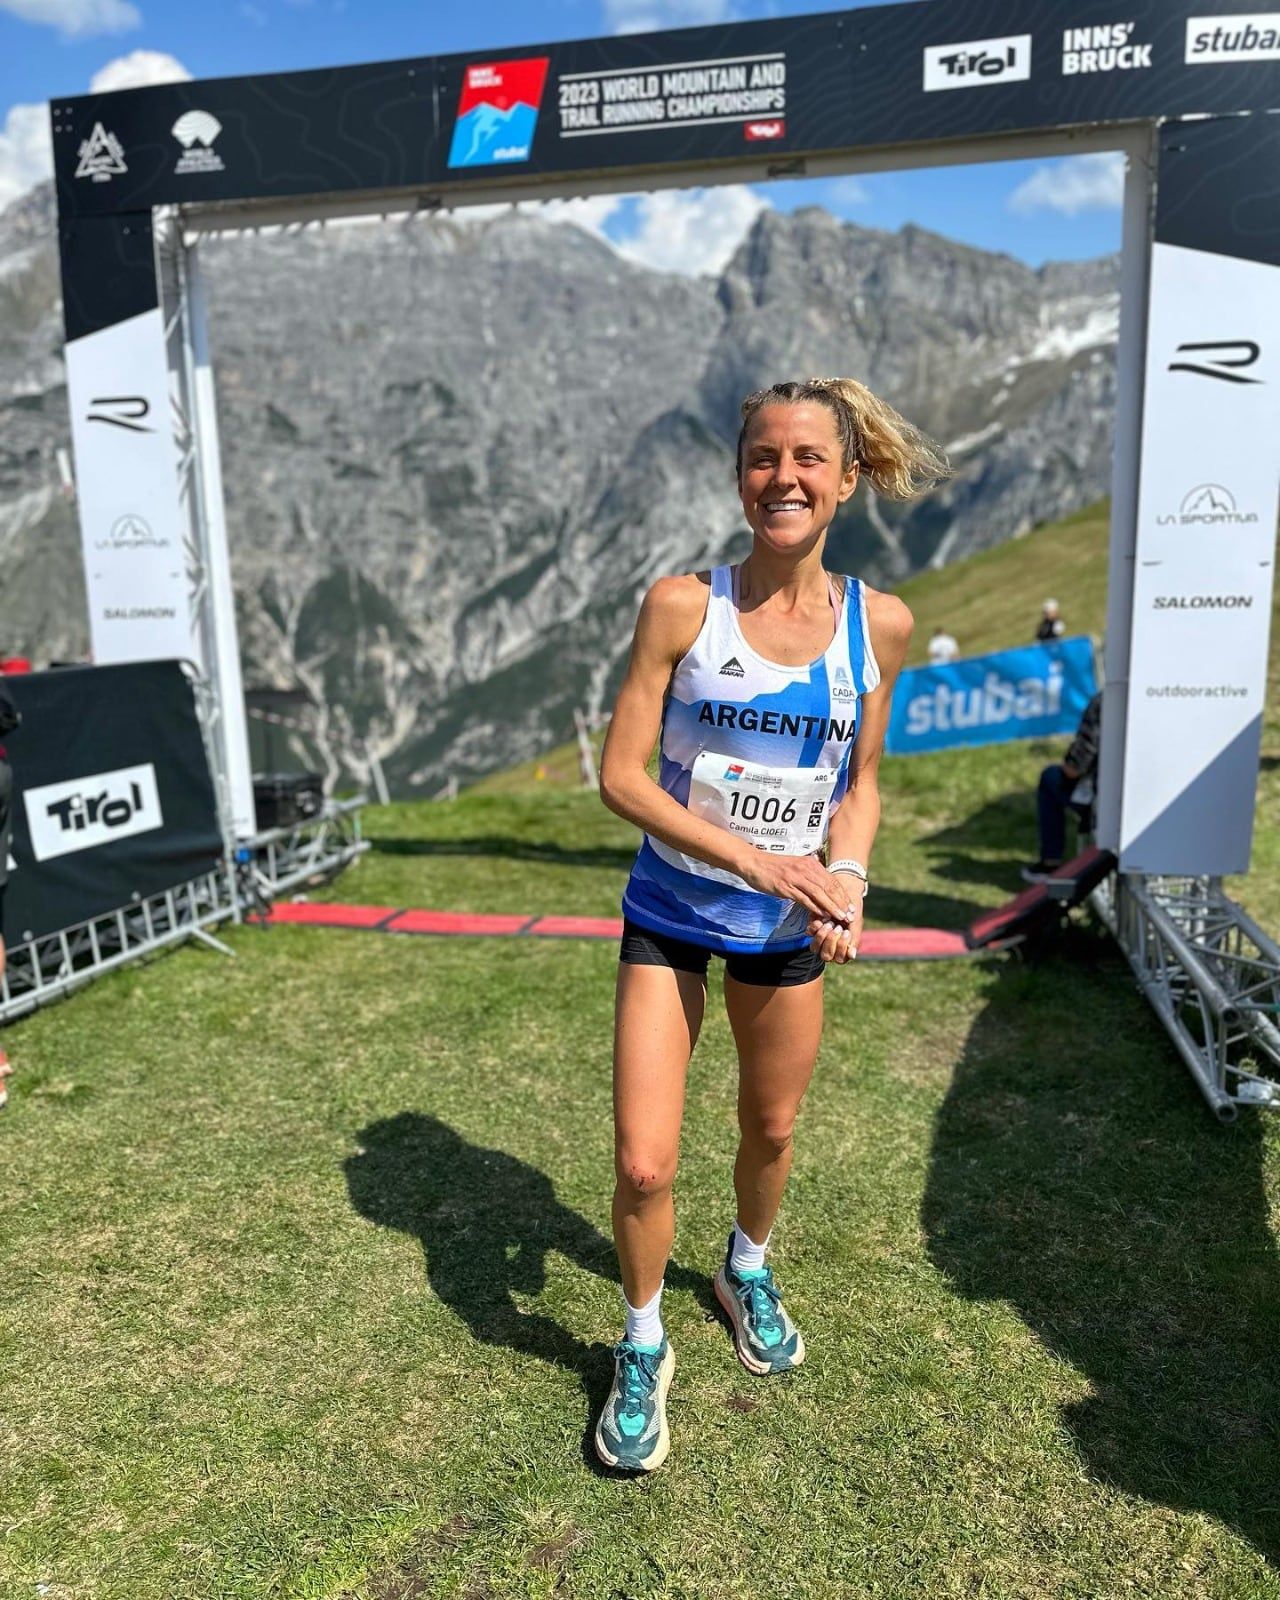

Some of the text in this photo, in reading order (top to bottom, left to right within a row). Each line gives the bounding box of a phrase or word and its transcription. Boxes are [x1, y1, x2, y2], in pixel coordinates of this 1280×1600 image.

[938, 47, 1016, 77] Tirol
[1062, 45, 1153, 76] BRUCK
[559, 62, 786, 107] 2023 WORLD MOUNTAIN AND
[560, 87, 786, 129] TRAIL RUNNING CHAMPIONSHIPS
[1156, 513, 1259, 526] LA SPORTIVA
[103, 607, 176, 619] SALOMON
[1152, 596, 1253, 610] SALOMON
[832, 687, 855, 698] CADA
[904, 660, 1065, 736] stubai
[1146, 684, 1248, 699] outdooractive
[699, 701, 856, 742] ARGENTINA
[46, 781, 143, 832] Tirol
[730, 791, 796, 823] 1006
[729, 821, 788, 837] Camila CIOFFI
